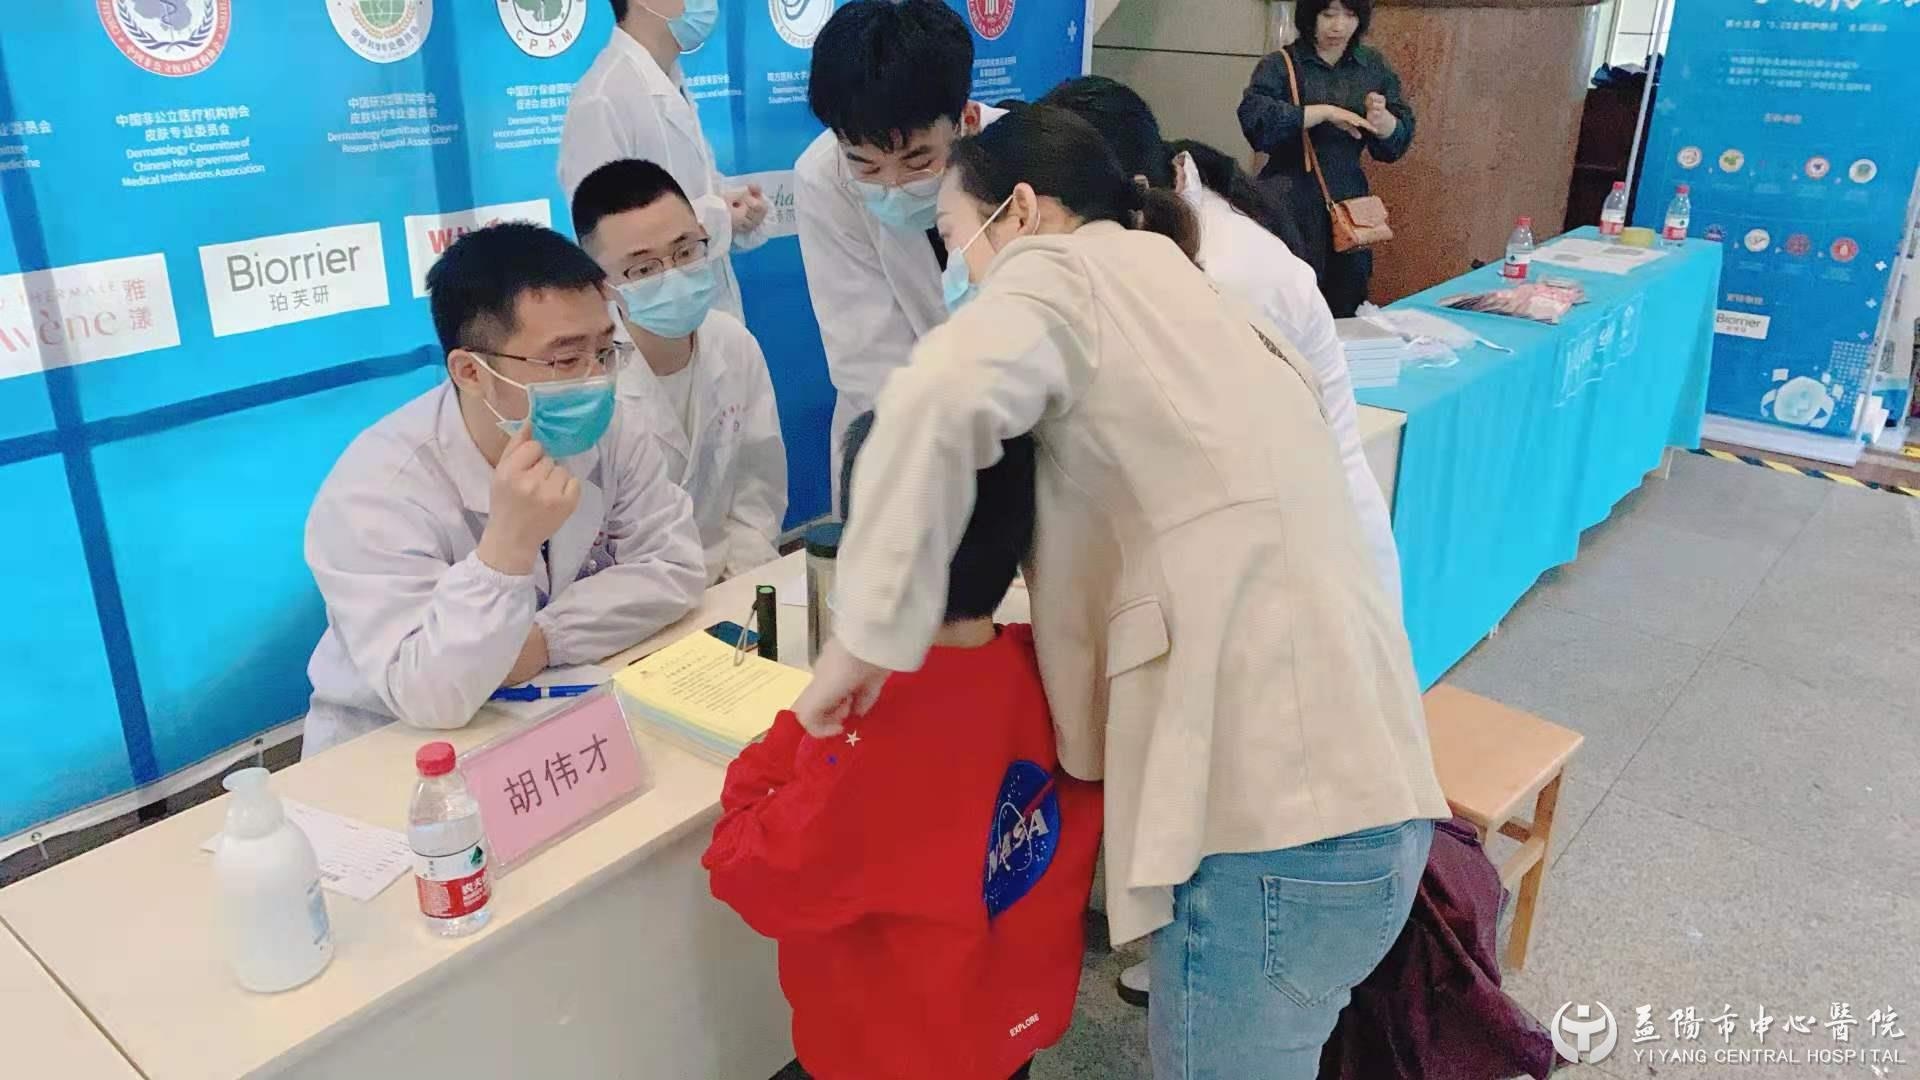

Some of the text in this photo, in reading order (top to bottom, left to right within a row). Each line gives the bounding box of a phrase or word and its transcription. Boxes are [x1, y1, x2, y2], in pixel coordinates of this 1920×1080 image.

[515, 28, 574, 51] CPAM
[115, 105, 250, 128] 中国非公立医疗机构协会
[144, 123, 230, 142] 皮肤专业委员会
[327, 130, 380, 142] Dermatology
[126, 136, 250, 160] Dermatology Committee of
[341, 142, 379, 153] Research
[121, 164, 265, 187] Medical Institutions Association
[133, 160, 172, 173] Chinese
[226, 242, 360, 292] Biorrier
[269, 284, 330, 313] 珀芙研
[503, 733, 608, 815] 胡伟才
[988, 808, 1051, 883] NASA
[1010, 1013, 1040, 1037] EXPLORE
